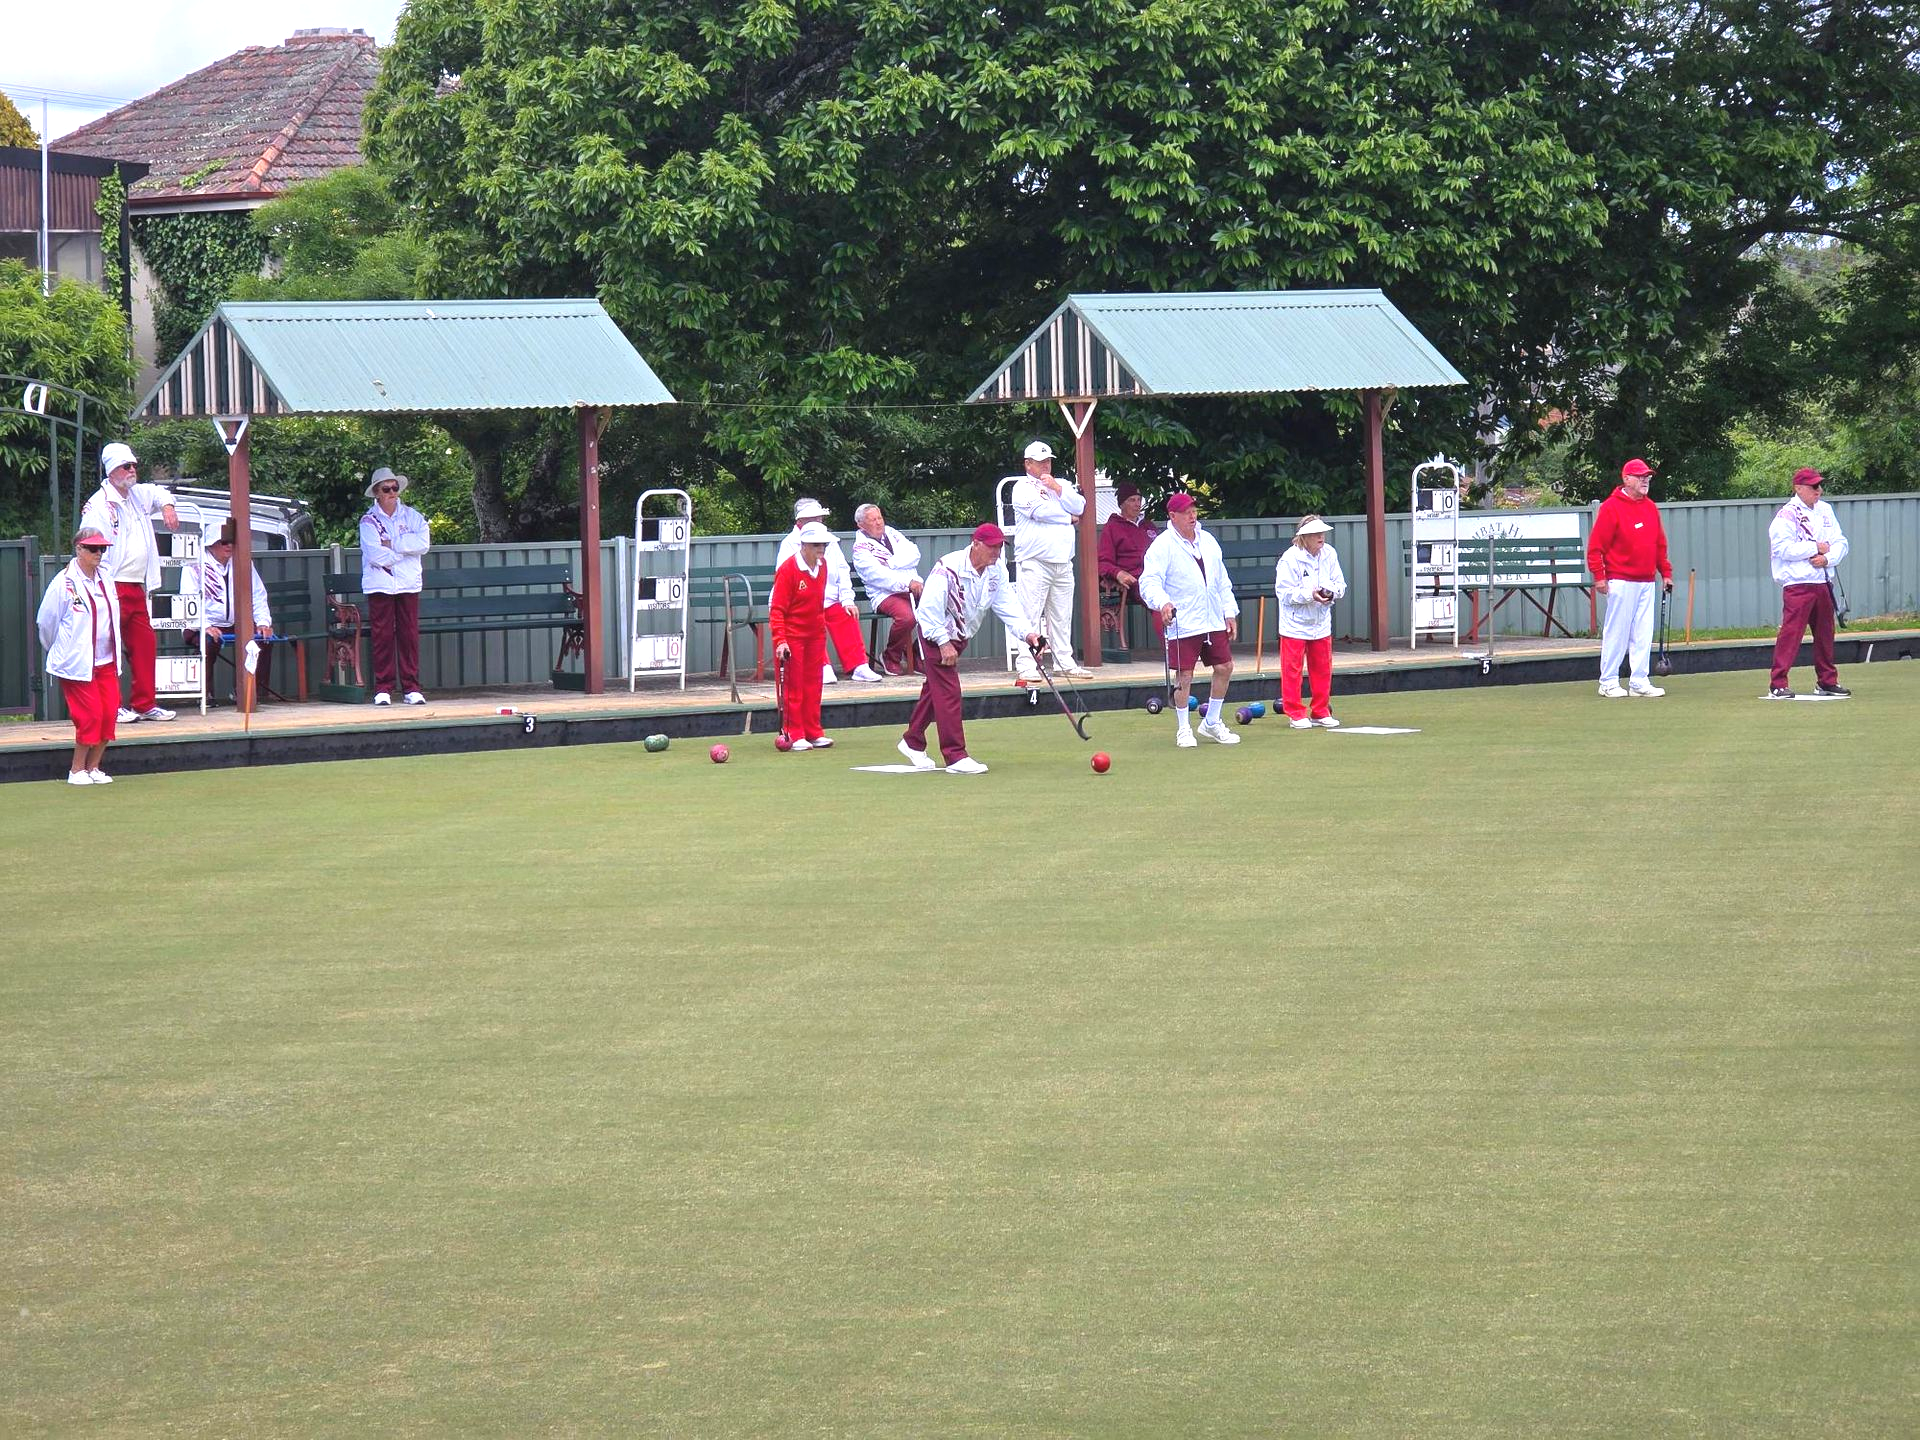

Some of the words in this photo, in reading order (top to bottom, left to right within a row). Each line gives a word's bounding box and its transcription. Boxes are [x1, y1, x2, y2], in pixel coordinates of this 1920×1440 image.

[675, 525, 684, 540] 0
[188, 541, 194, 556] 1
[1446, 550, 1451, 563] 1
[672, 584, 681, 598] 0
[188, 601, 197, 616] 0
[1446, 602, 1452, 615] 1
[160, 621, 187, 629] VISITORS
[671, 642, 679, 656] 0
[191, 664, 196, 679] 1
[1482, 660, 1490, 674] 5
[1030, 690, 1038, 705] 4
[525, 716, 535, 733] 3
